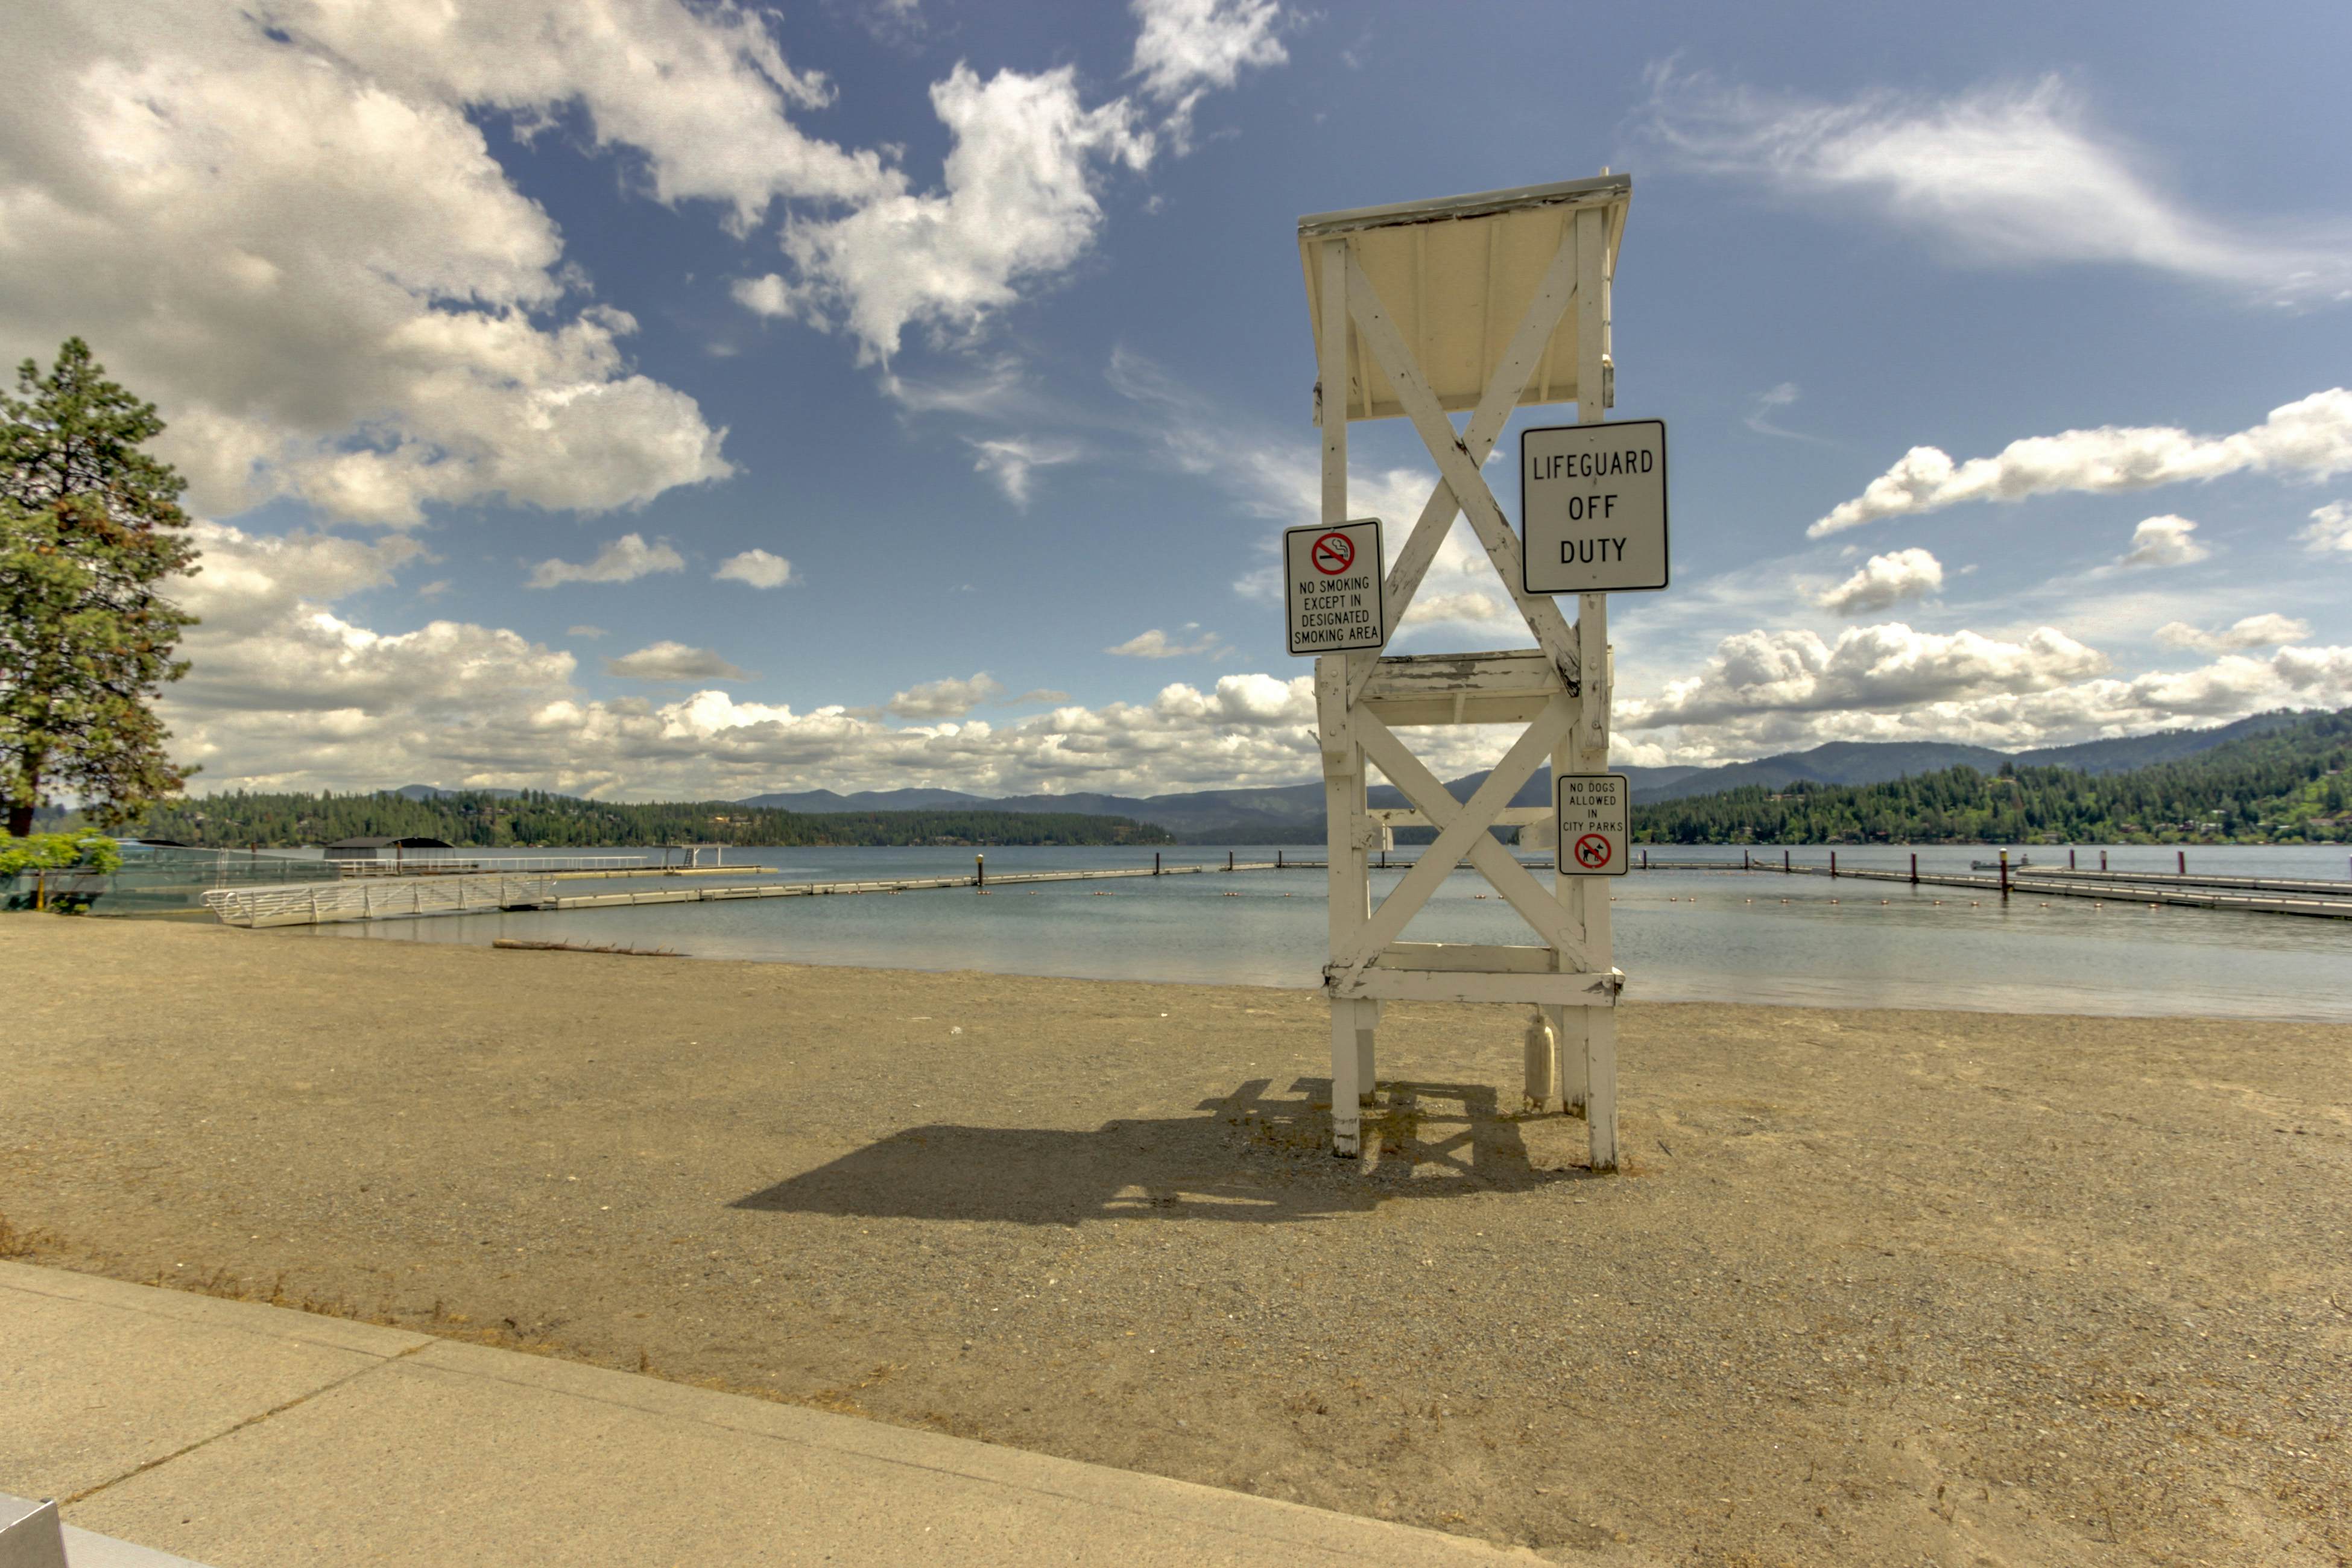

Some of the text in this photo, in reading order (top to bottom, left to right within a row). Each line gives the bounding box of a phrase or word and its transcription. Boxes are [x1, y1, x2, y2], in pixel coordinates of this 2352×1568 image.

[1534, 450, 1652, 480] LIFEGUARD
[1569, 495, 1618, 520] OFF
[1561, 537, 1627, 564] DUTY
[1300, 577, 1370, 594] NO SMOKING
[1304, 594, 1361, 610] EXCEPT IN
[1302, 610, 1369, 627] DESIGNATED
[1294, 626, 1378, 644] SMOKING AREA
[1570, 783, 1615, 792] NO DOGS
[1569, 796, 1616, 805] ALLOWED
[1588, 809, 1597, 818] IN
[1563, 822, 1623, 831] CITY PARKS
